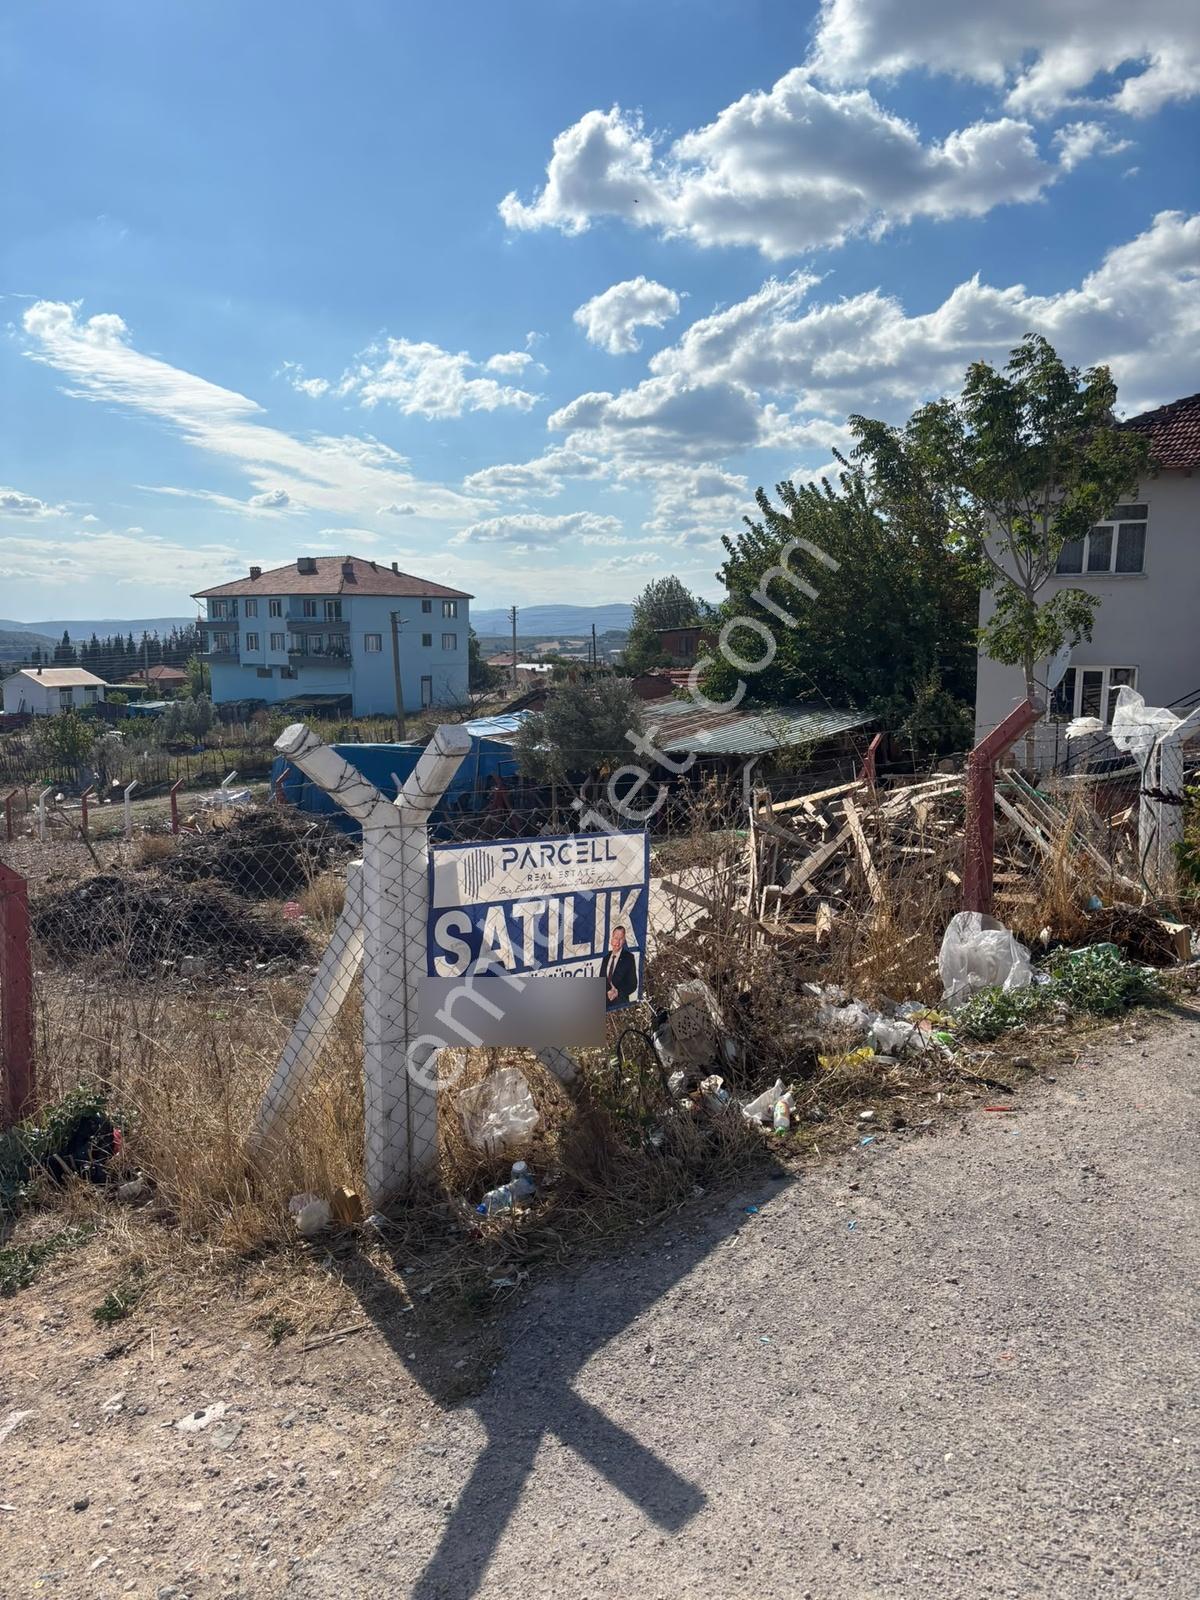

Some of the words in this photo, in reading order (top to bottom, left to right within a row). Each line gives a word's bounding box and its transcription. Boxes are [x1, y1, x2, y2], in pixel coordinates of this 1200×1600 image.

[502, 839, 617, 871] PARCELL
[527, 871, 552, 882] REAL
[558, 868, 597, 879] ESTATE
[433, 888, 642, 977] SATILIK
